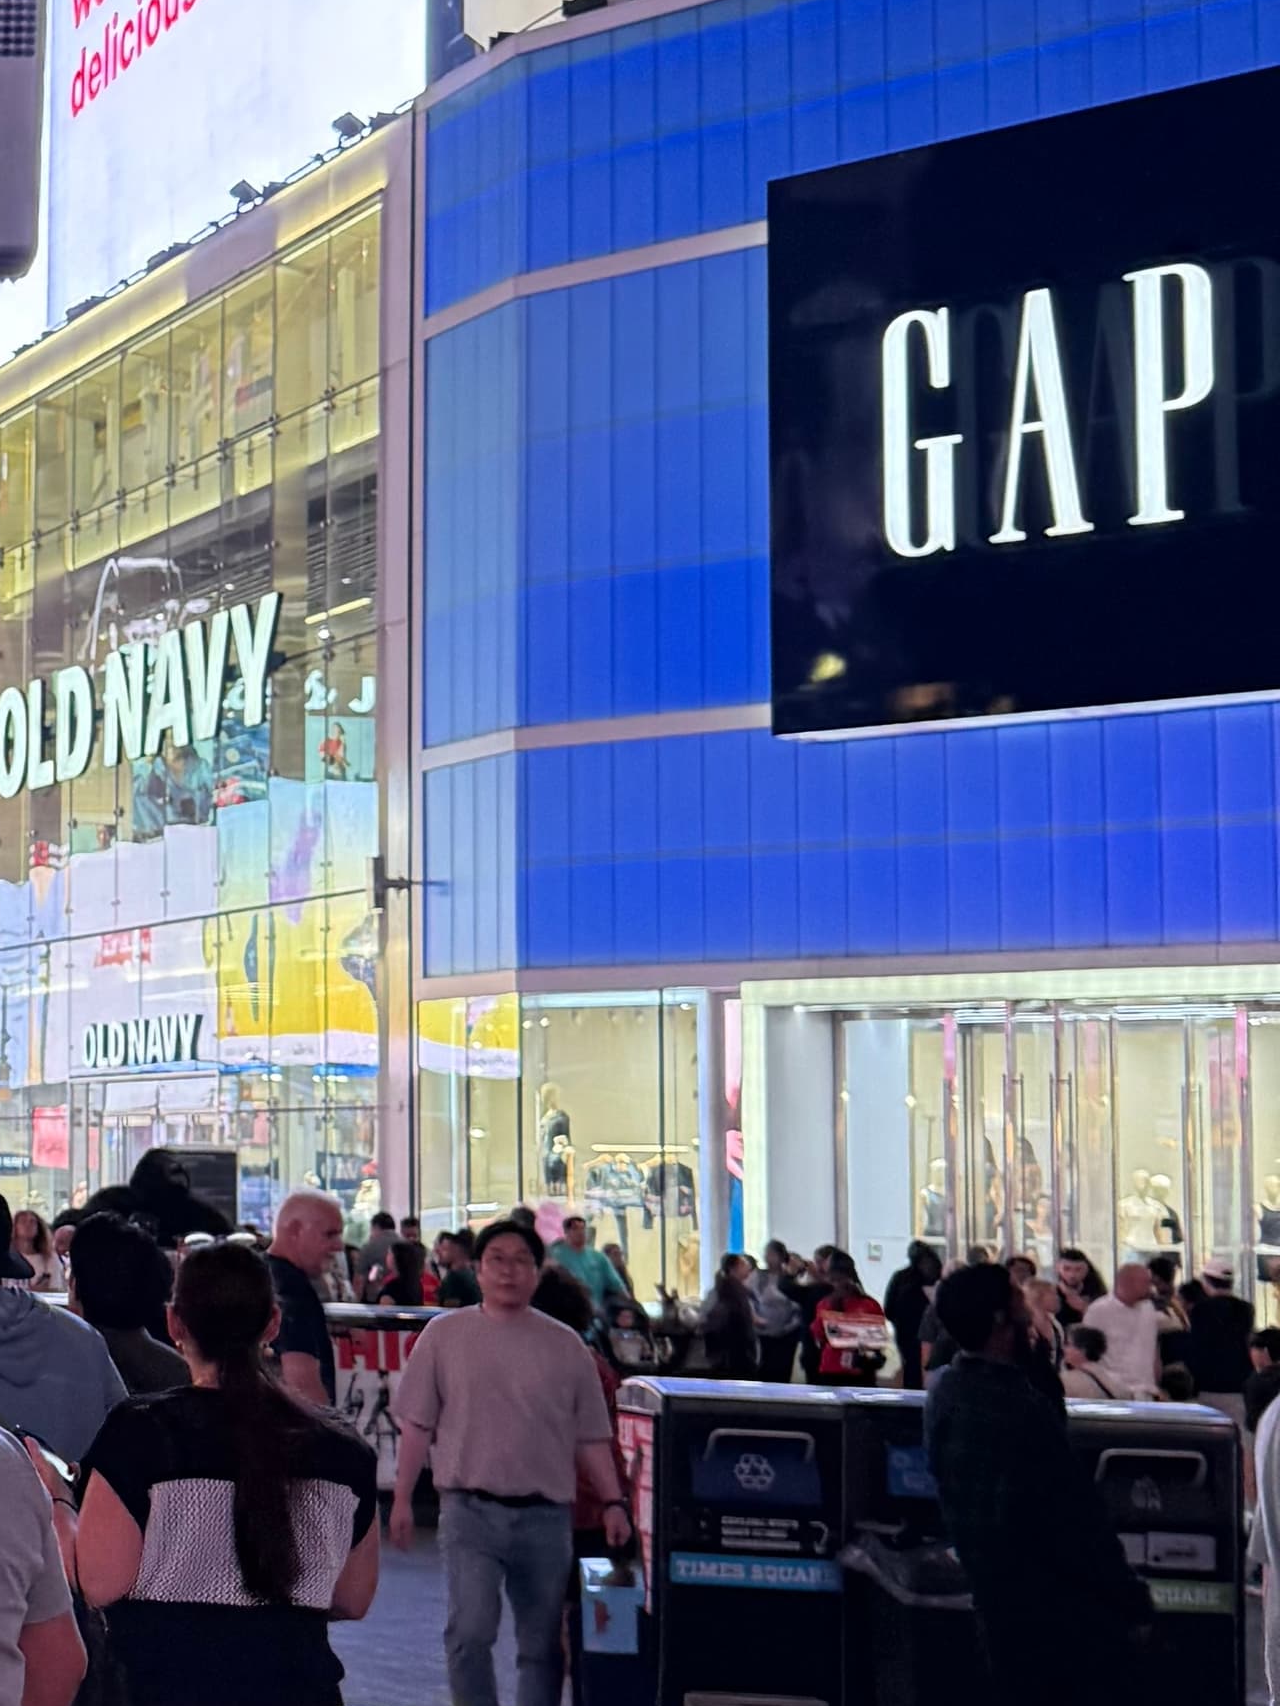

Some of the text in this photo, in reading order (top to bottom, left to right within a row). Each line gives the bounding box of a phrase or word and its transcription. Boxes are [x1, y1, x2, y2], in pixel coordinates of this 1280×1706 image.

[882, 262, 1215, 559] GAP
[103, 592, 283, 768] NAVY
[82, 1014, 203, 1068] OLD NAVY
[675, 1558, 744, 1579] TIMES
[1151, 1585, 1221, 1607] QUARE
